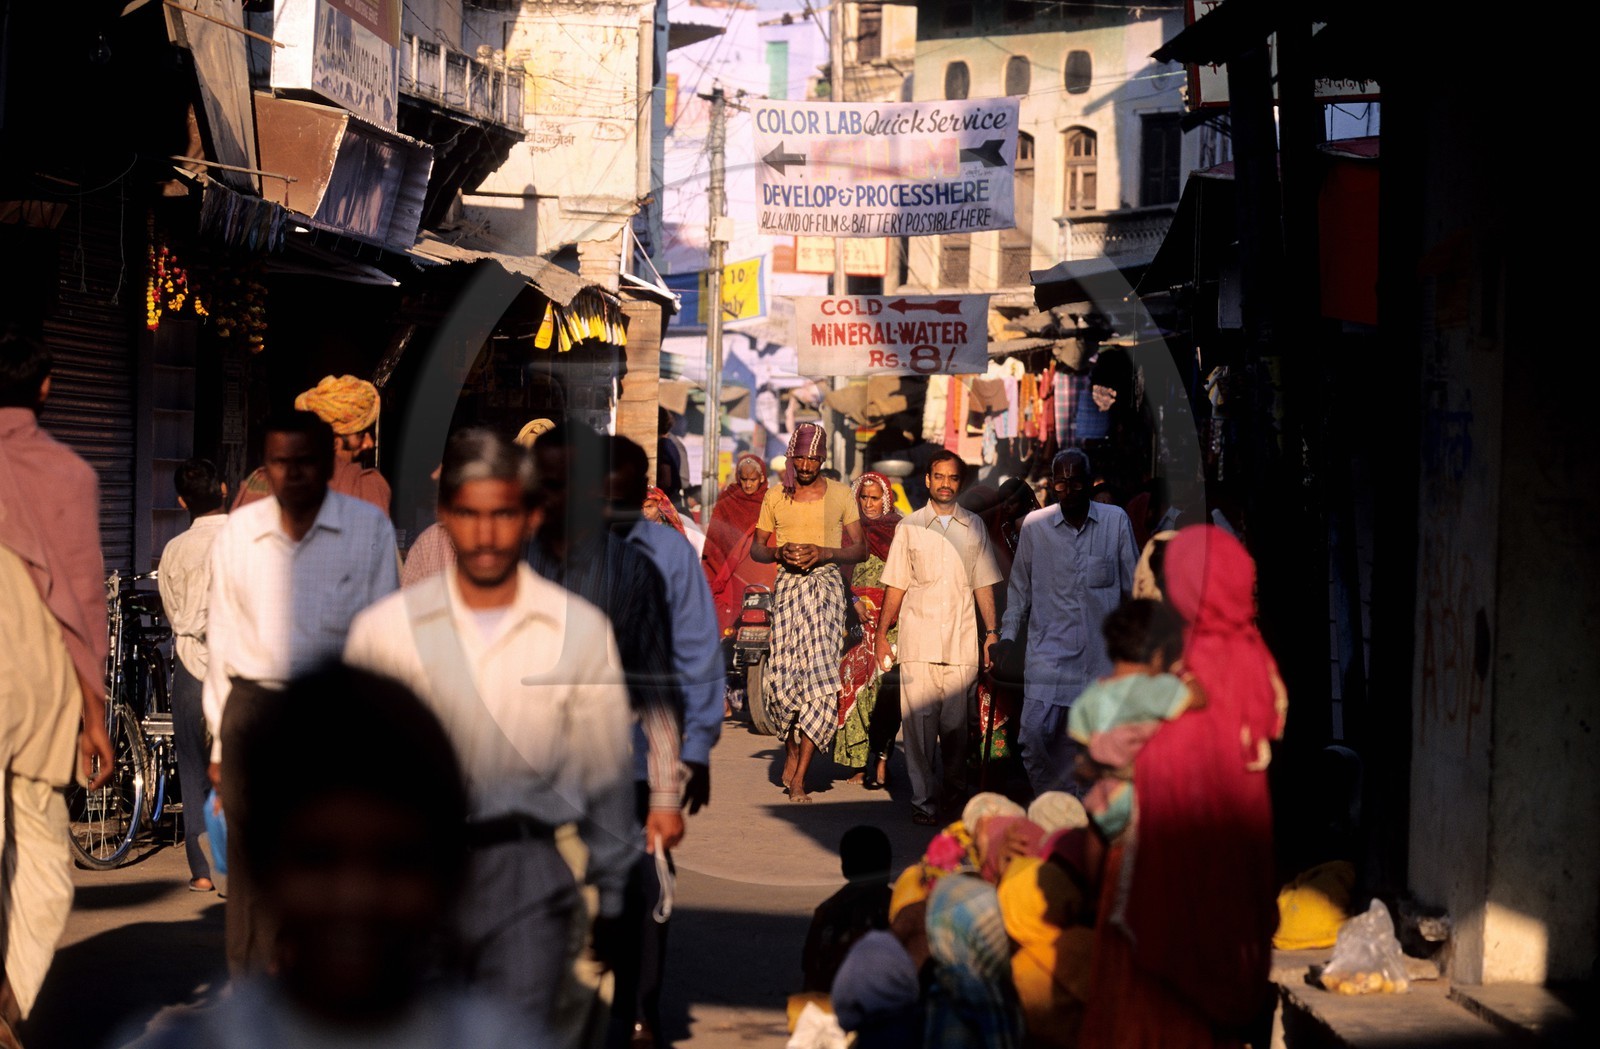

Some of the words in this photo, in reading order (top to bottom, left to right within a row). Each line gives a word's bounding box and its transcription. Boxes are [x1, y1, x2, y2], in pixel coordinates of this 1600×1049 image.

[756, 108, 824, 135] COLOR
[826, 110, 862, 135] LAB
[863, 109, 925, 136] Quick
[926, 108, 1008, 133] Service
[763, 183, 837, 208] DEVELOP
[856, 184, 934, 208] PROCESS
[935, 179, 990, 205] HERE
[761, 211, 777, 229] ALL
[777, 212, 801, 232] KIND
[802, 213, 815, 232] OF
[816, 213, 839, 232] FILM
[840, 215, 851, 232] &
[851, 212, 904, 234] BATTERY
[905, 210, 959, 233] POSSIBLE
[959, 208, 992, 229] HERE
[821, 298, 883, 316] COLD
[869, 350, 907, 369] Rs.
